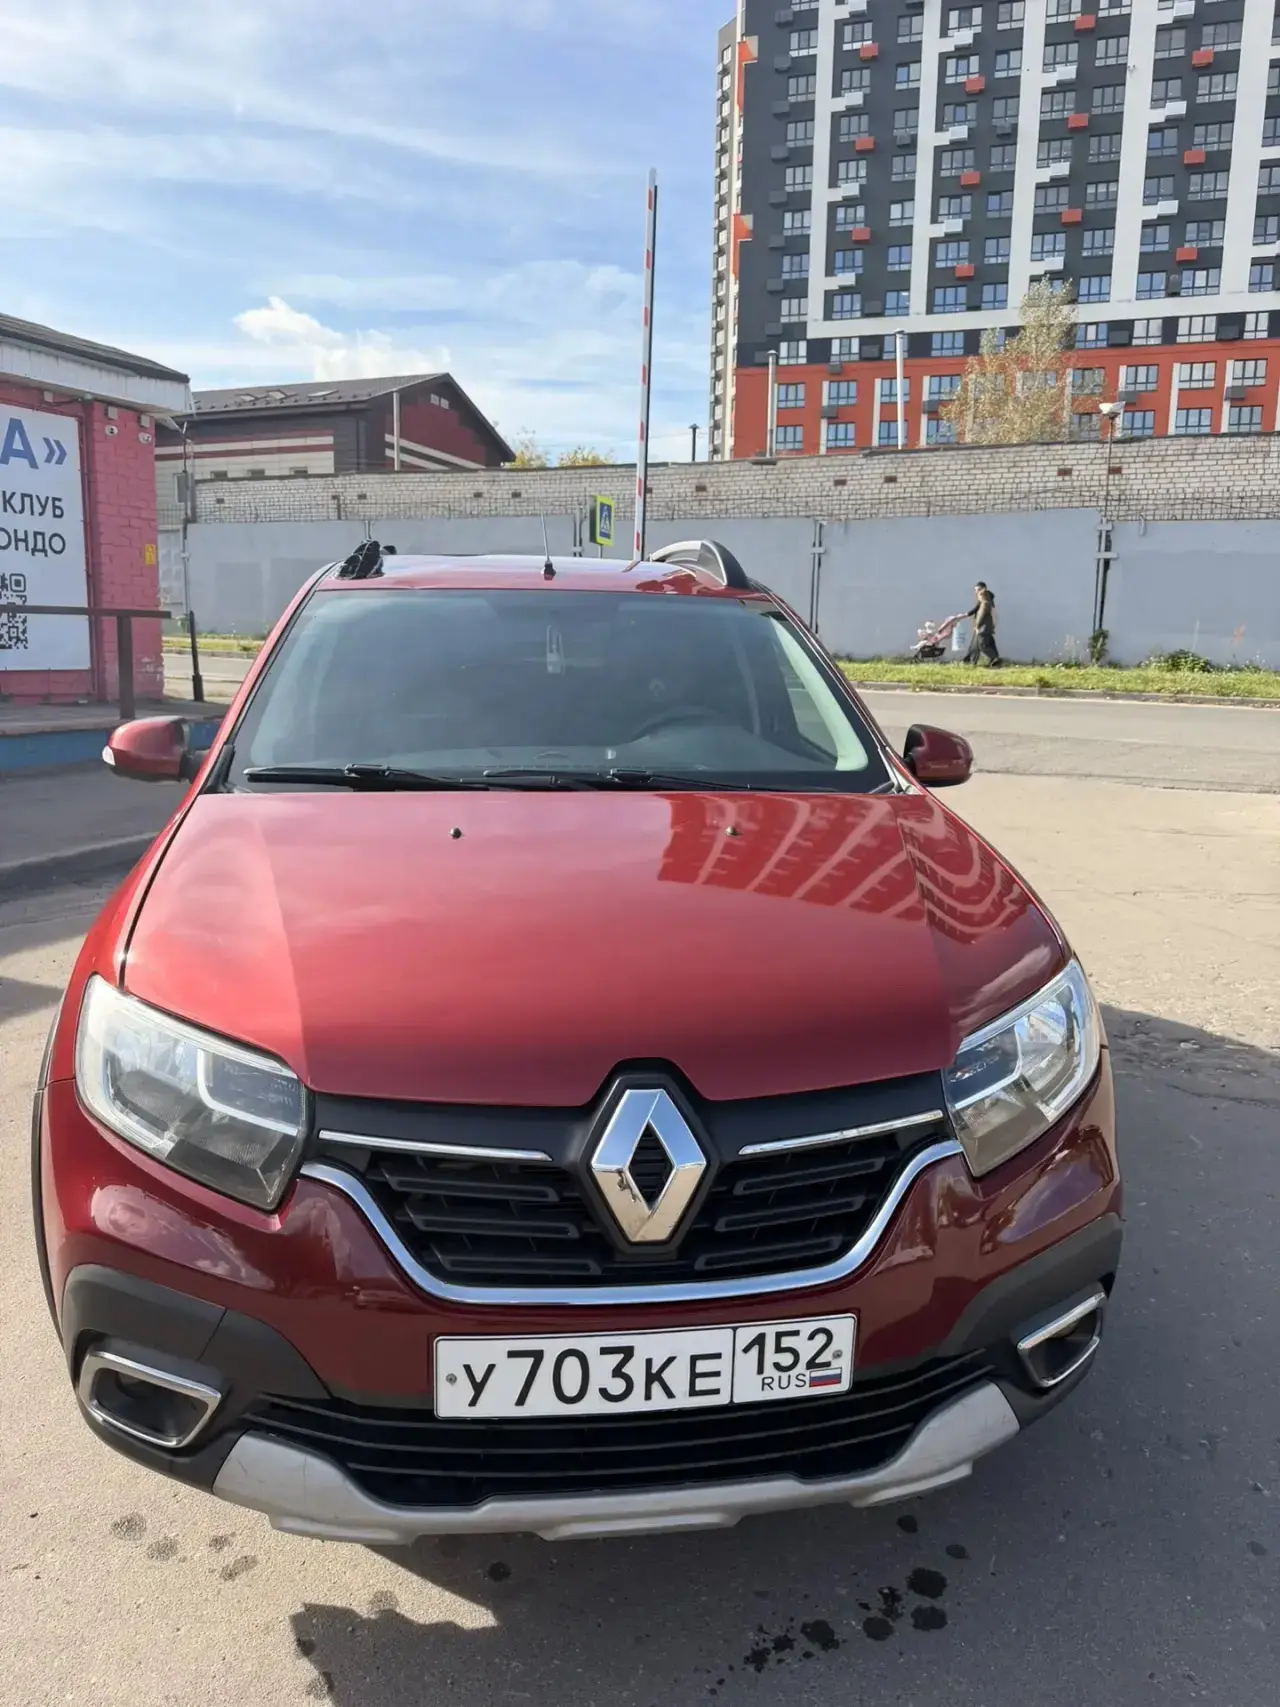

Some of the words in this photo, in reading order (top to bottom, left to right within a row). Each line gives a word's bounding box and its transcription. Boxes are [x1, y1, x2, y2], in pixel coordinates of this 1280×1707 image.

[2, 490, 65, 519] КЛУБ
[741, 1327, 834, 1375] 152
[761, 1373, 807, 1392] RUS
